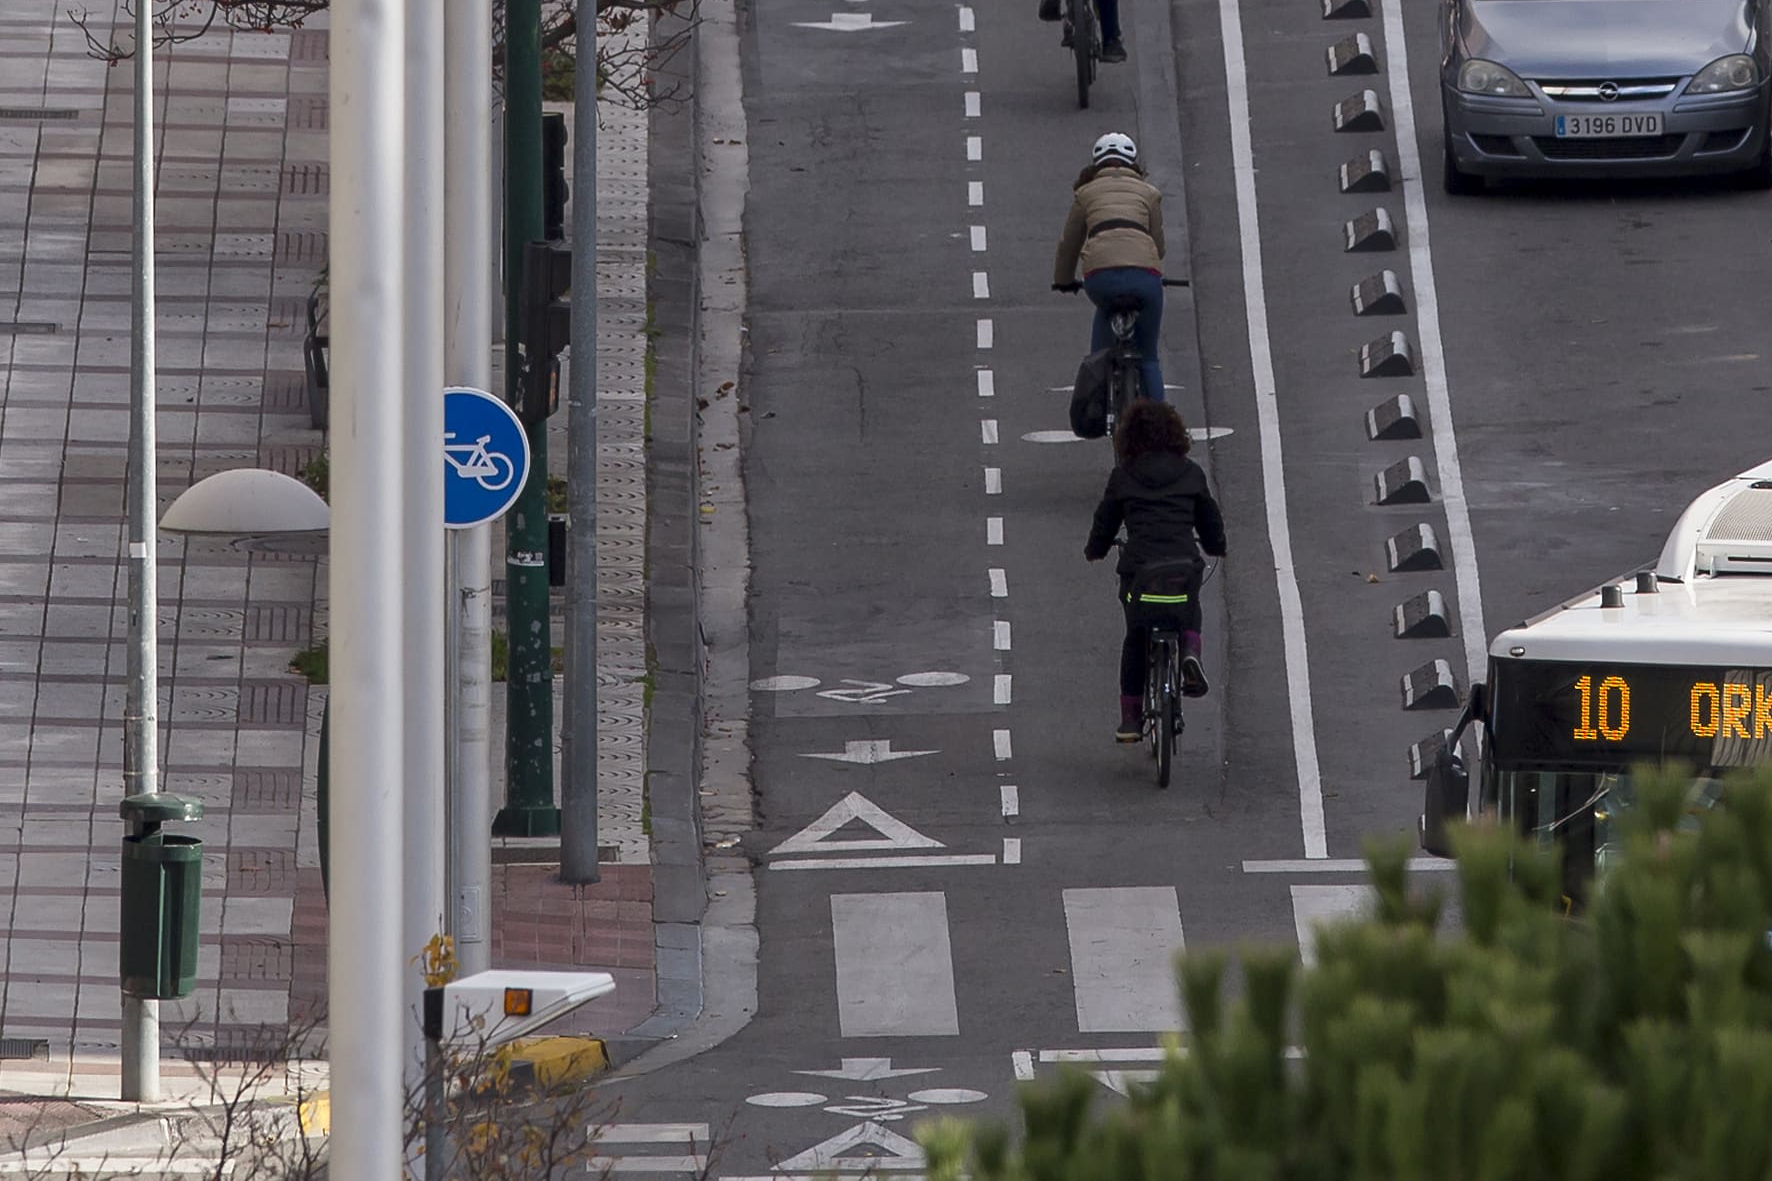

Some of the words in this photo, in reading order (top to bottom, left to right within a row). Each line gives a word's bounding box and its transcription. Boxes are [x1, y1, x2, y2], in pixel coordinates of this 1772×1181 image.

[1570, 117, 1616, 135] 3196
[1622, 116, 1657, 134] DVD
[1573, 675, 1631, 741] 10
